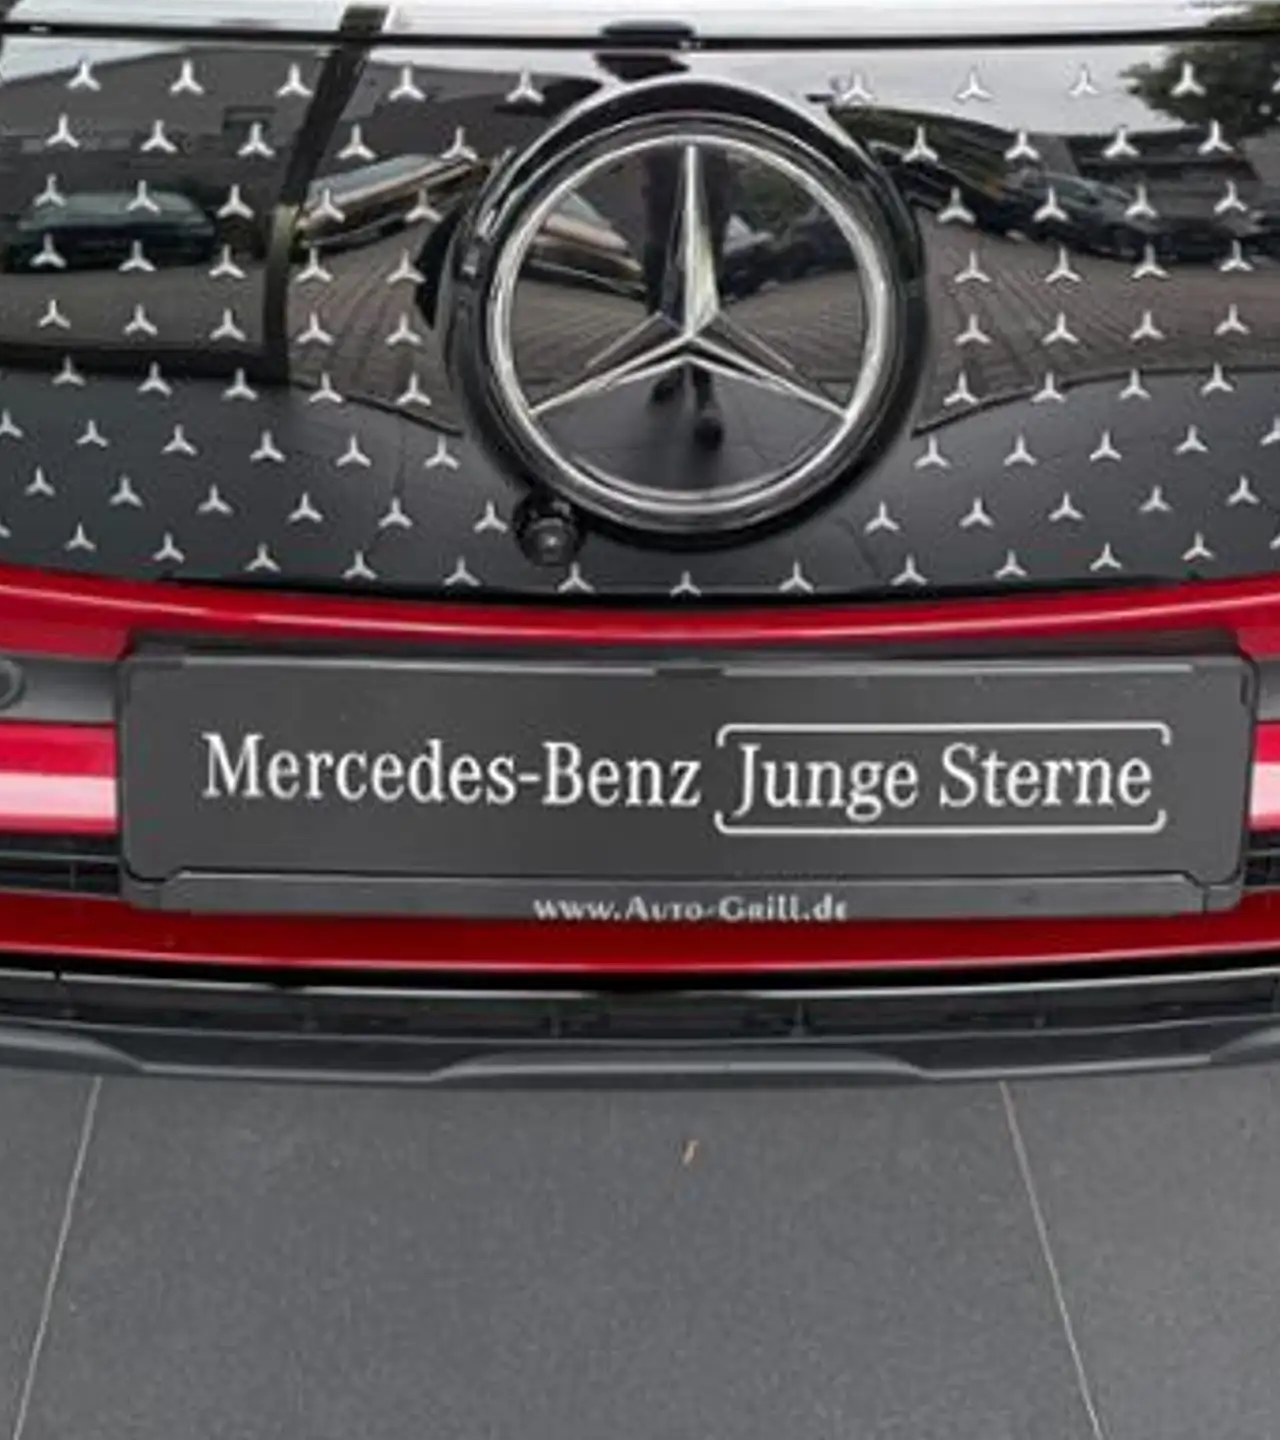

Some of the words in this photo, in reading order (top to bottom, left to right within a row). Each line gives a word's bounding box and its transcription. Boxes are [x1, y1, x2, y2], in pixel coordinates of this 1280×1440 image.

[200, 731, 703, 808] Mercedes-Benz
[731, 742, 919, 823] Junge
[939, 741, 1153, 808] Sterne
